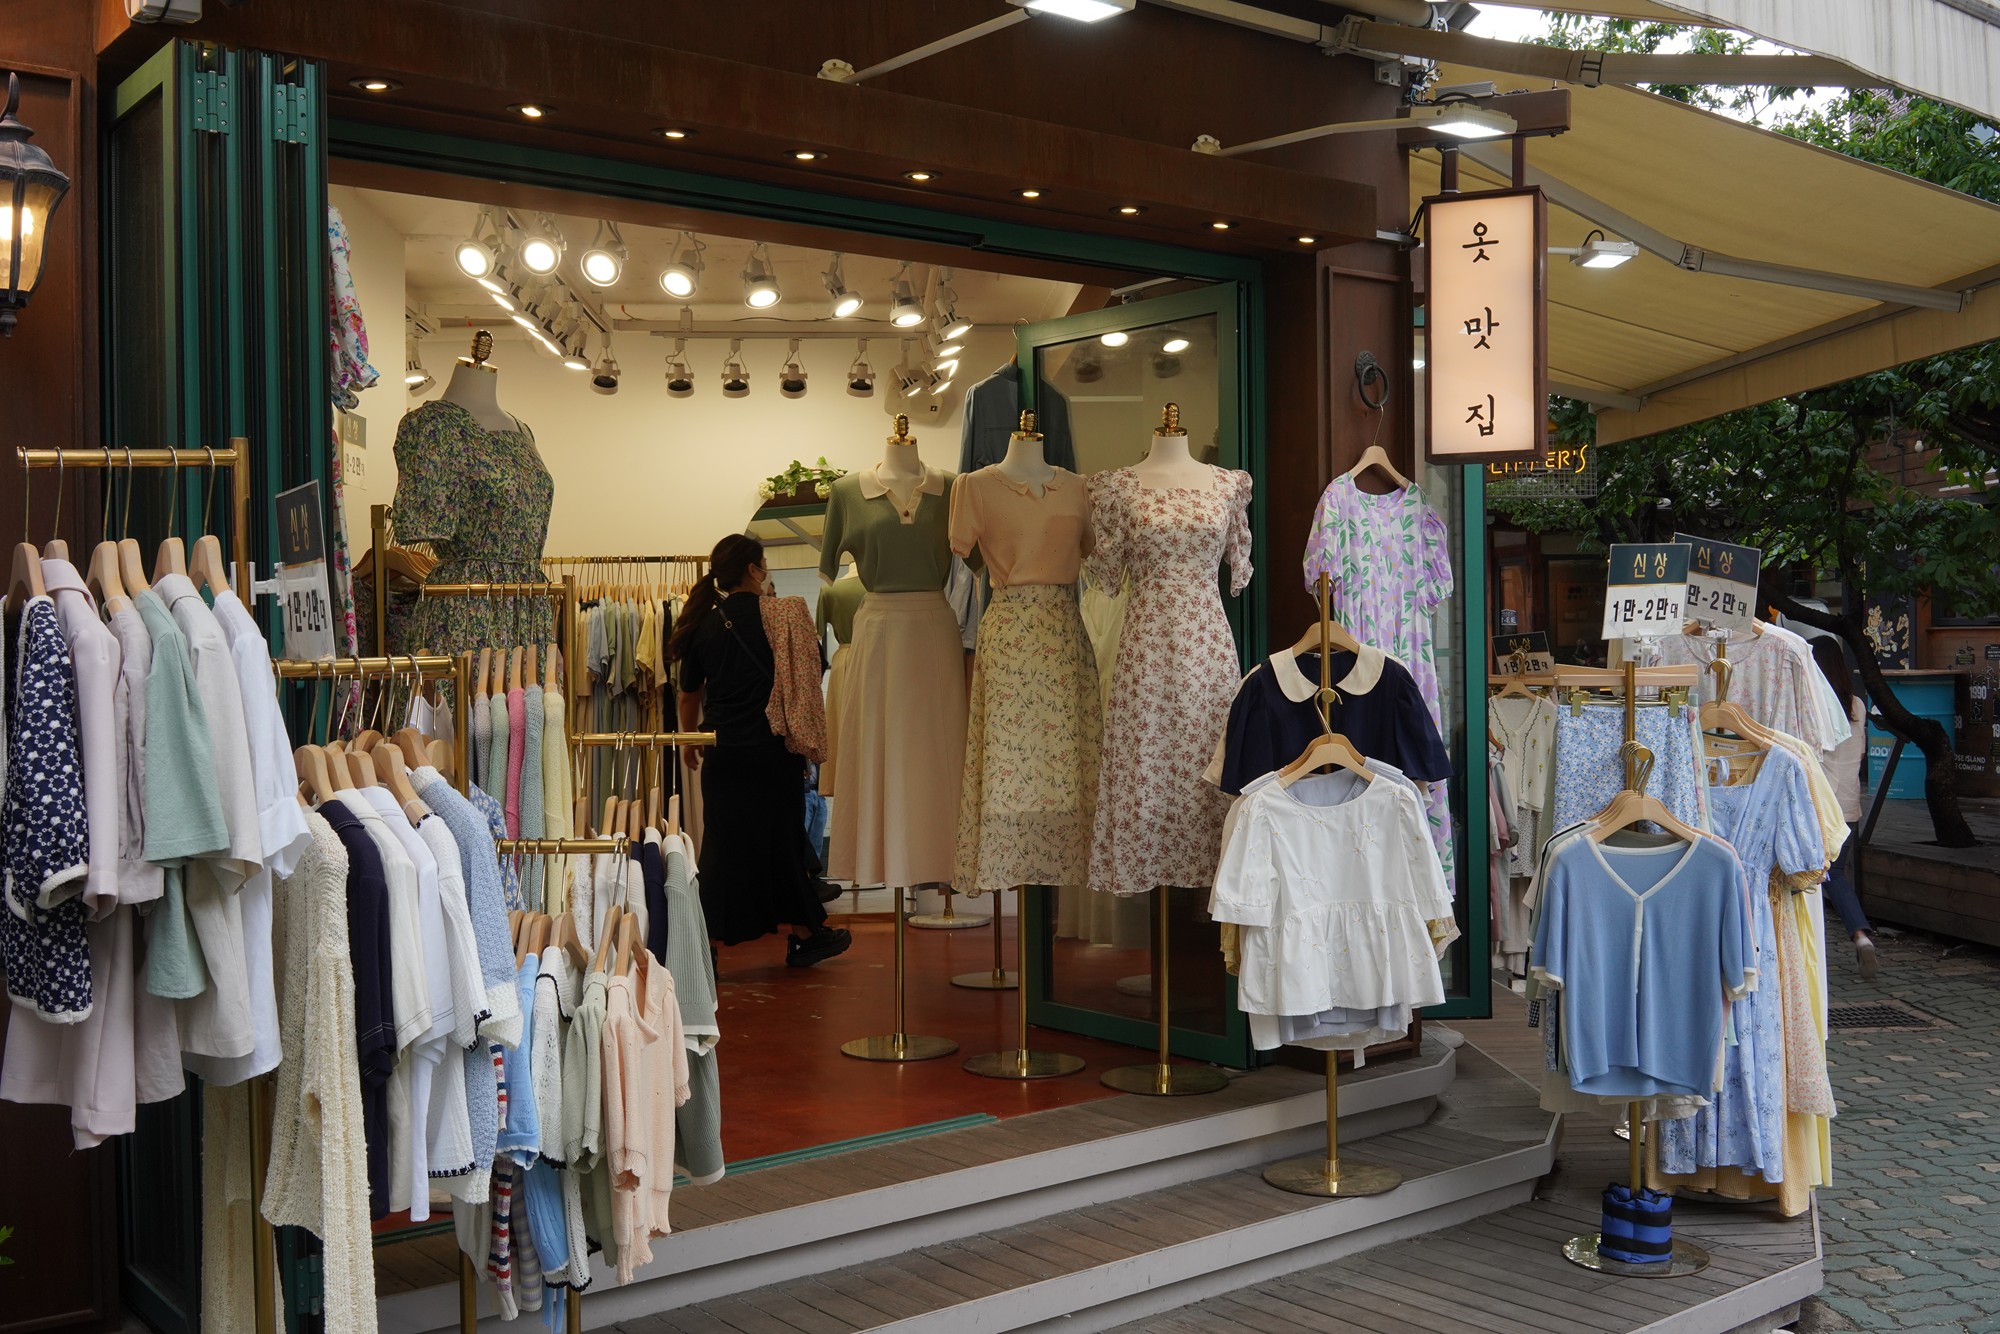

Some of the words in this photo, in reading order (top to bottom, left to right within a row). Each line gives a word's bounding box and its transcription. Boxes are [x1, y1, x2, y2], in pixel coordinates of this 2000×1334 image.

[290, 503, 310, 552] 신상
[1633, 552, 1668, 579] 신상
[1697, 546, 1734, 575] 신상
[1612, 598, 1679, 623] 1만-2만대
[1687, 583, 1748, 618] 만-2만대
[1969, 685, 1987, 700] 1990
[1964, 754, 1986, 764] ISLAND
